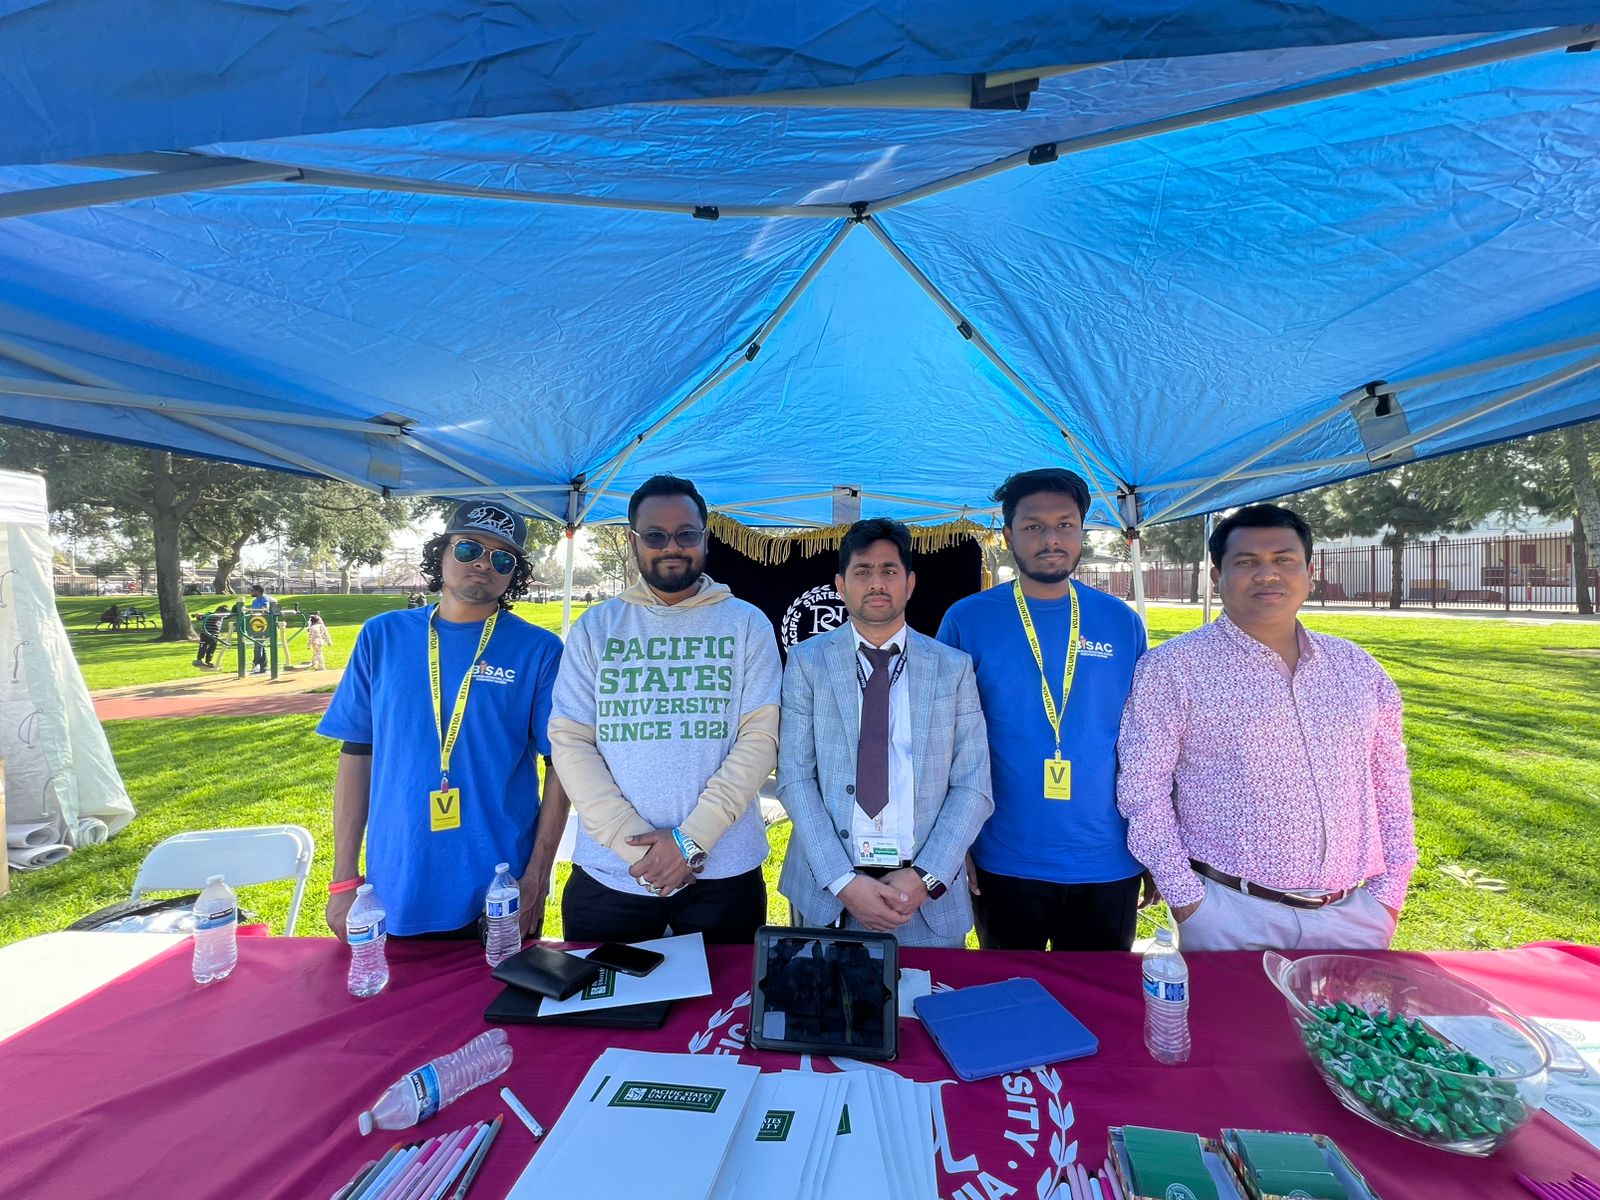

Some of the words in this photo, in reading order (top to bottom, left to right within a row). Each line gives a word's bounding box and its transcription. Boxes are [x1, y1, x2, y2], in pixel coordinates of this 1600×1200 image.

[803, 591, 841, 608] STATES
[1016, 595, 1032, 628] VOLUNTEER
[479, 616, 496, 651] VOLUNTEER
[789, 610, 802, 645] ACIFIC
[601, 635, 735, 662] PACIFIC
[1065, 639, 1077, 677] VOLUNTEER
[430, 661, 440, 701] VOLUNTEER
[599, 665, 732, 694] STATES
[599, 697, 731, 717] UNIVERSITY
[1042, 684, 1057, 724] VOLUNTEER
[444, 712, 462, 753] VOLUNTEER
[599, 721, 672, 742] SINCE
[680, 720, 729, 739] 1928
[1049, 766, 1065, 784] V
[436, 796, 454, 814] V
[684, 1091, 713, 1100] STATES
